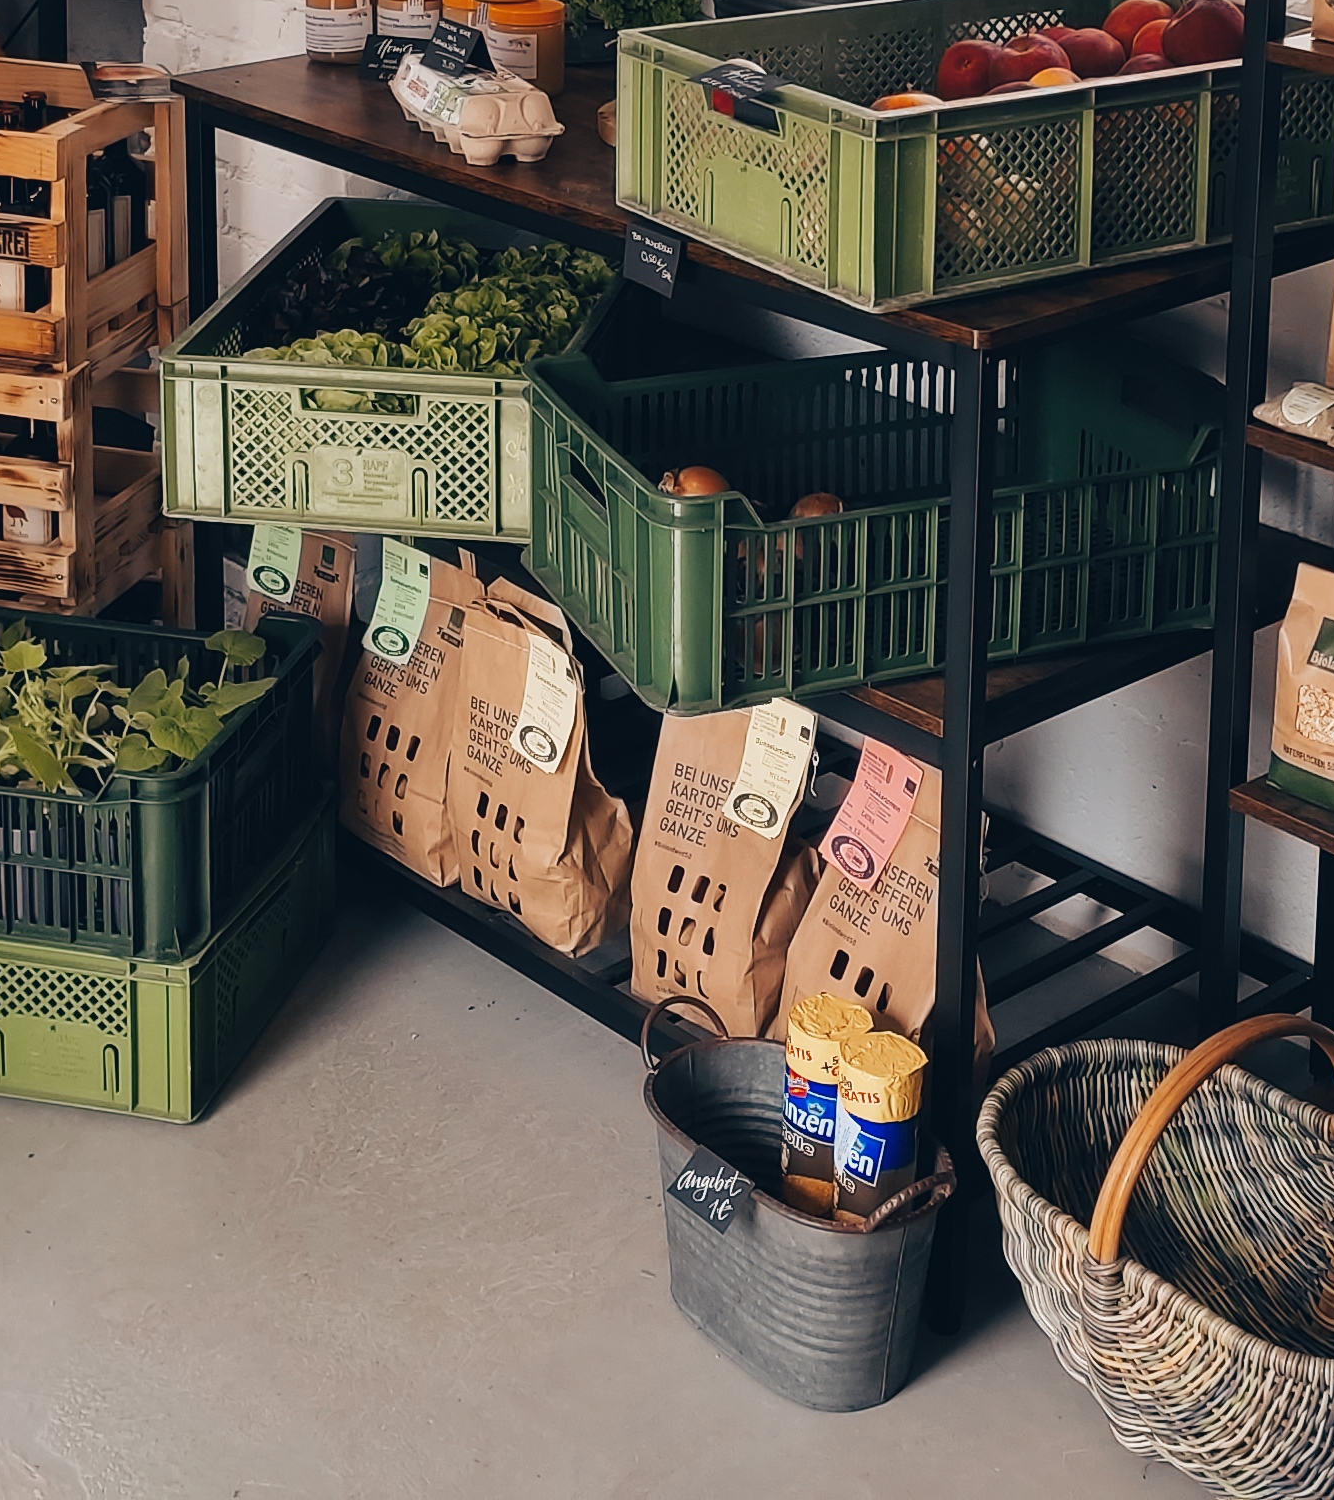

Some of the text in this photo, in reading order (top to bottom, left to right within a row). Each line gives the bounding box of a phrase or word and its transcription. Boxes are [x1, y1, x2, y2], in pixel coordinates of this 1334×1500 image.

[295, 580, 323, 601] SEREN
[415, 639, 446, 666] SEREN
[364, 671, 398, 700] GANZE.
[370, 655, 430, 695] GEHT'S UMS
[470, 695, 490, 716] BEI
[467, 744, 503, 778] GANZE.
[469, 728, 533, 774] GEHT'S UMS
[674, 762, 696, 783] BEI
[659, 817, 708, 848] GANZE.
[665, 799, 741, 839] GEHT'S UMS
[875, 879, 925, 923] OFFELN
[883, 862, 934, 904] NSEREN
[829, 894, 871, 936] GANZE.
[838, 876, 880, 915] GEHT'S
[881, 905, 913, 937] UMS
[784, 1094, 834, 1138] inzen
[708, 1197, 734, 1222] 1€
